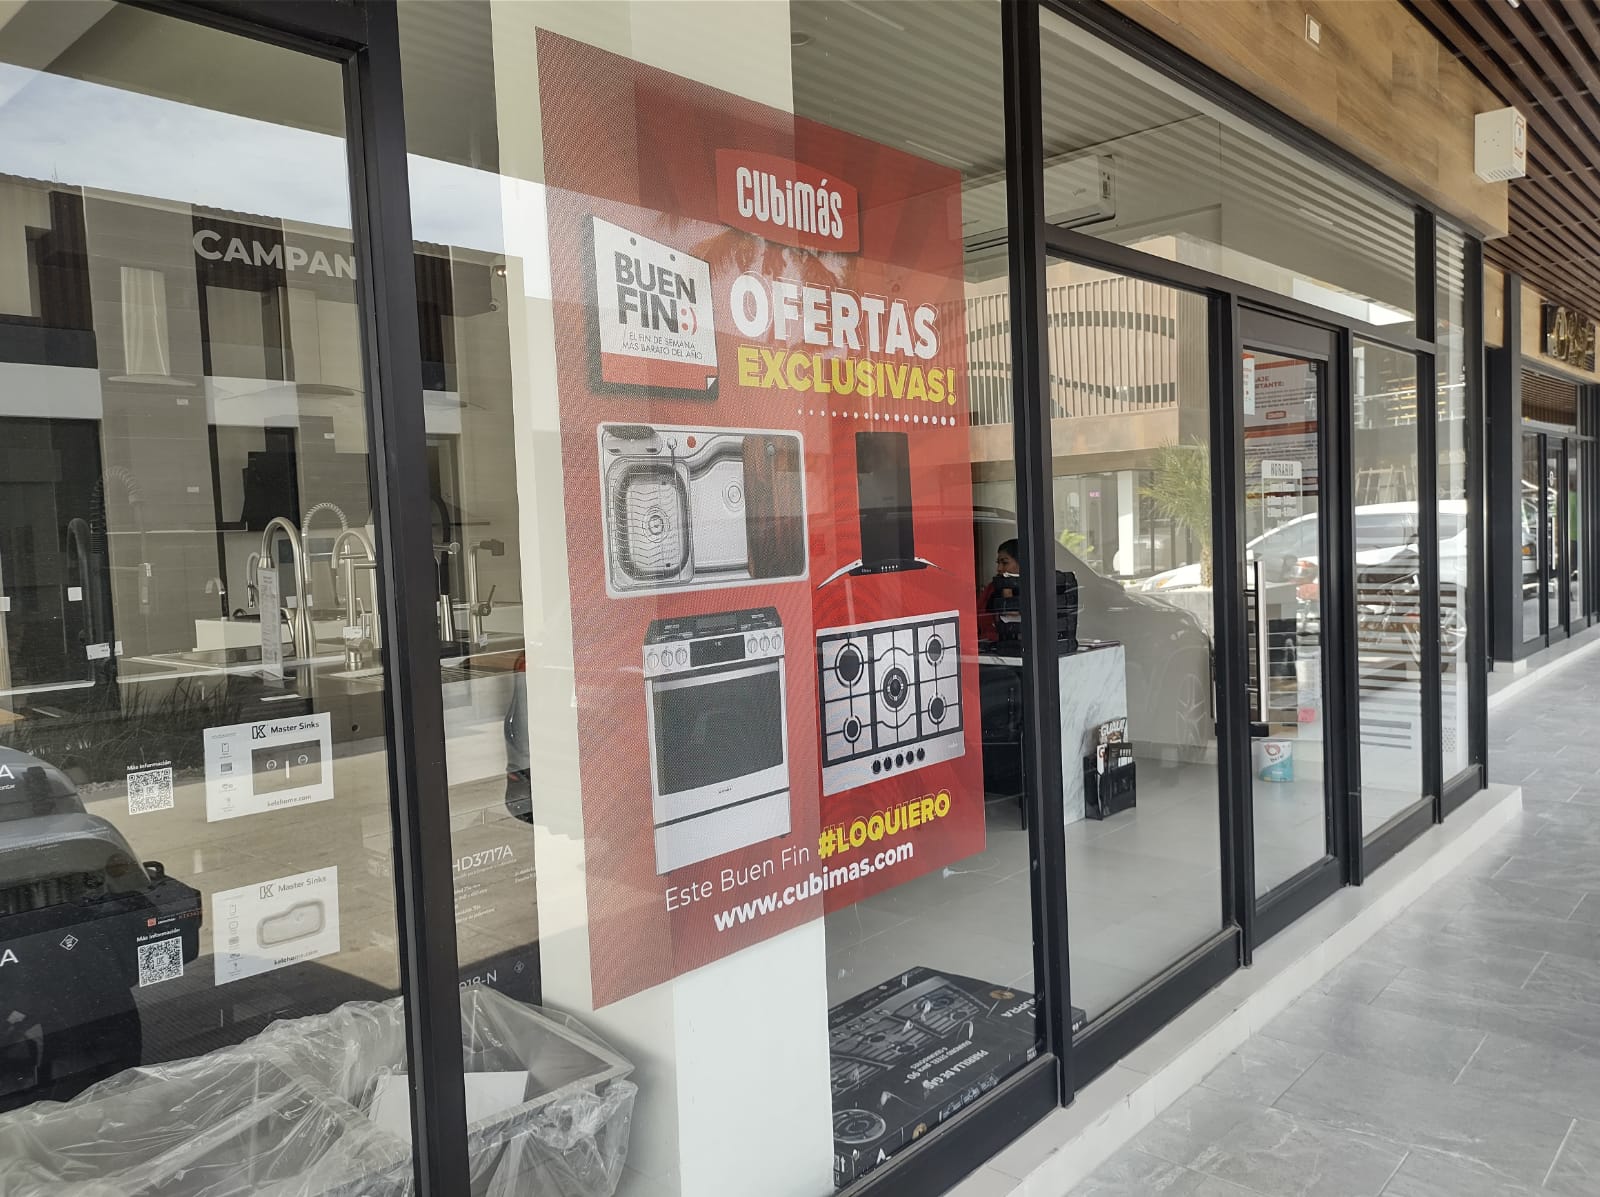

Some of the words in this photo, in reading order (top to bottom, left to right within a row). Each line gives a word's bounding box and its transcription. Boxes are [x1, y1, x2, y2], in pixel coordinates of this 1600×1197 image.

[193, 230, 357, 280] CAMPAN
[614, 250, 697, 304] BUEN
[639, 333, 651, 343] FIN
[654, 335, 663, 345] DE
[665, 337, 696, 350] SEMANA
[731, 272, 940, 359] OFERTAS
[641, 343, 670, 355] BARATO
[672, 347, 685, 358] DEL
[738, 344, 957, 405] EXCLUSIVAS!
[270, 724, 297, 734] Master
[299, 721, 320, 730] Sinks
[818, 788, 951, 859] #LOQUIERO
[278, 882, 304, 892] Master
[306, 876, 327, 886] Sinks
[665, 880, 713, 911] Este
[720, 858, 774, 893] Buen
[781, 845, 810, 872] Fin
[713, 841, 914, 932] www.cubimas.com
